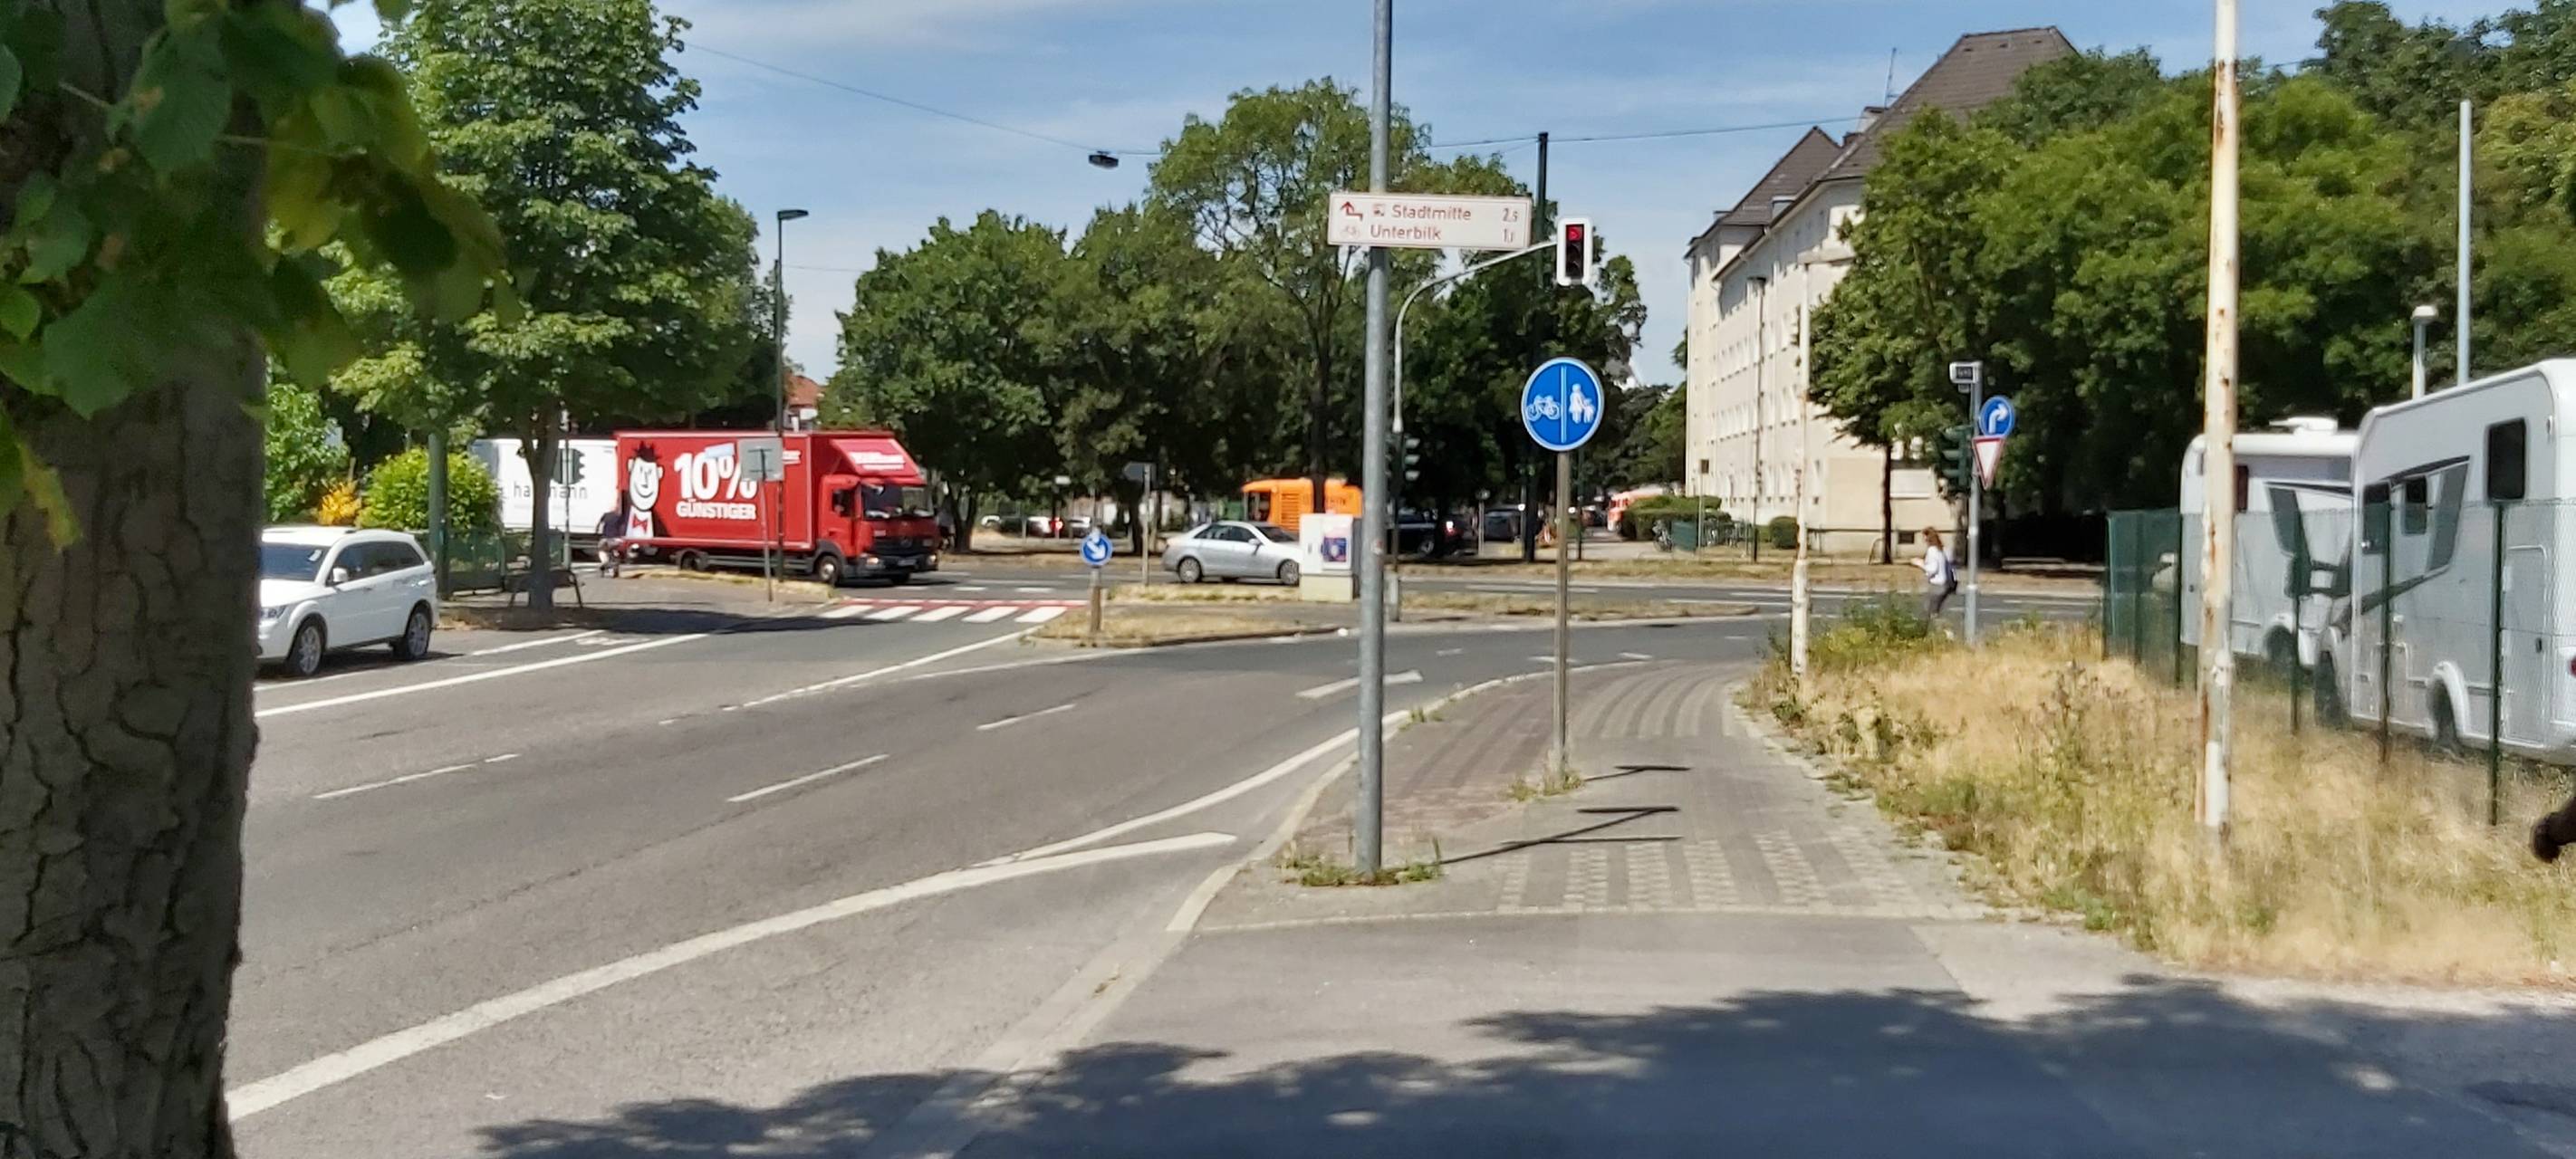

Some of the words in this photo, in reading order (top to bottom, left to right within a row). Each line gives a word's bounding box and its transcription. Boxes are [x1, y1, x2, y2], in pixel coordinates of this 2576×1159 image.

[1392, 204, 1472, 221] Stadtmitte
[1370, 225, 1441, 240] Unterbilk
[674, 453, 758, 500] 10%
[676, 499, 757, 520] GÜNSTIGER
